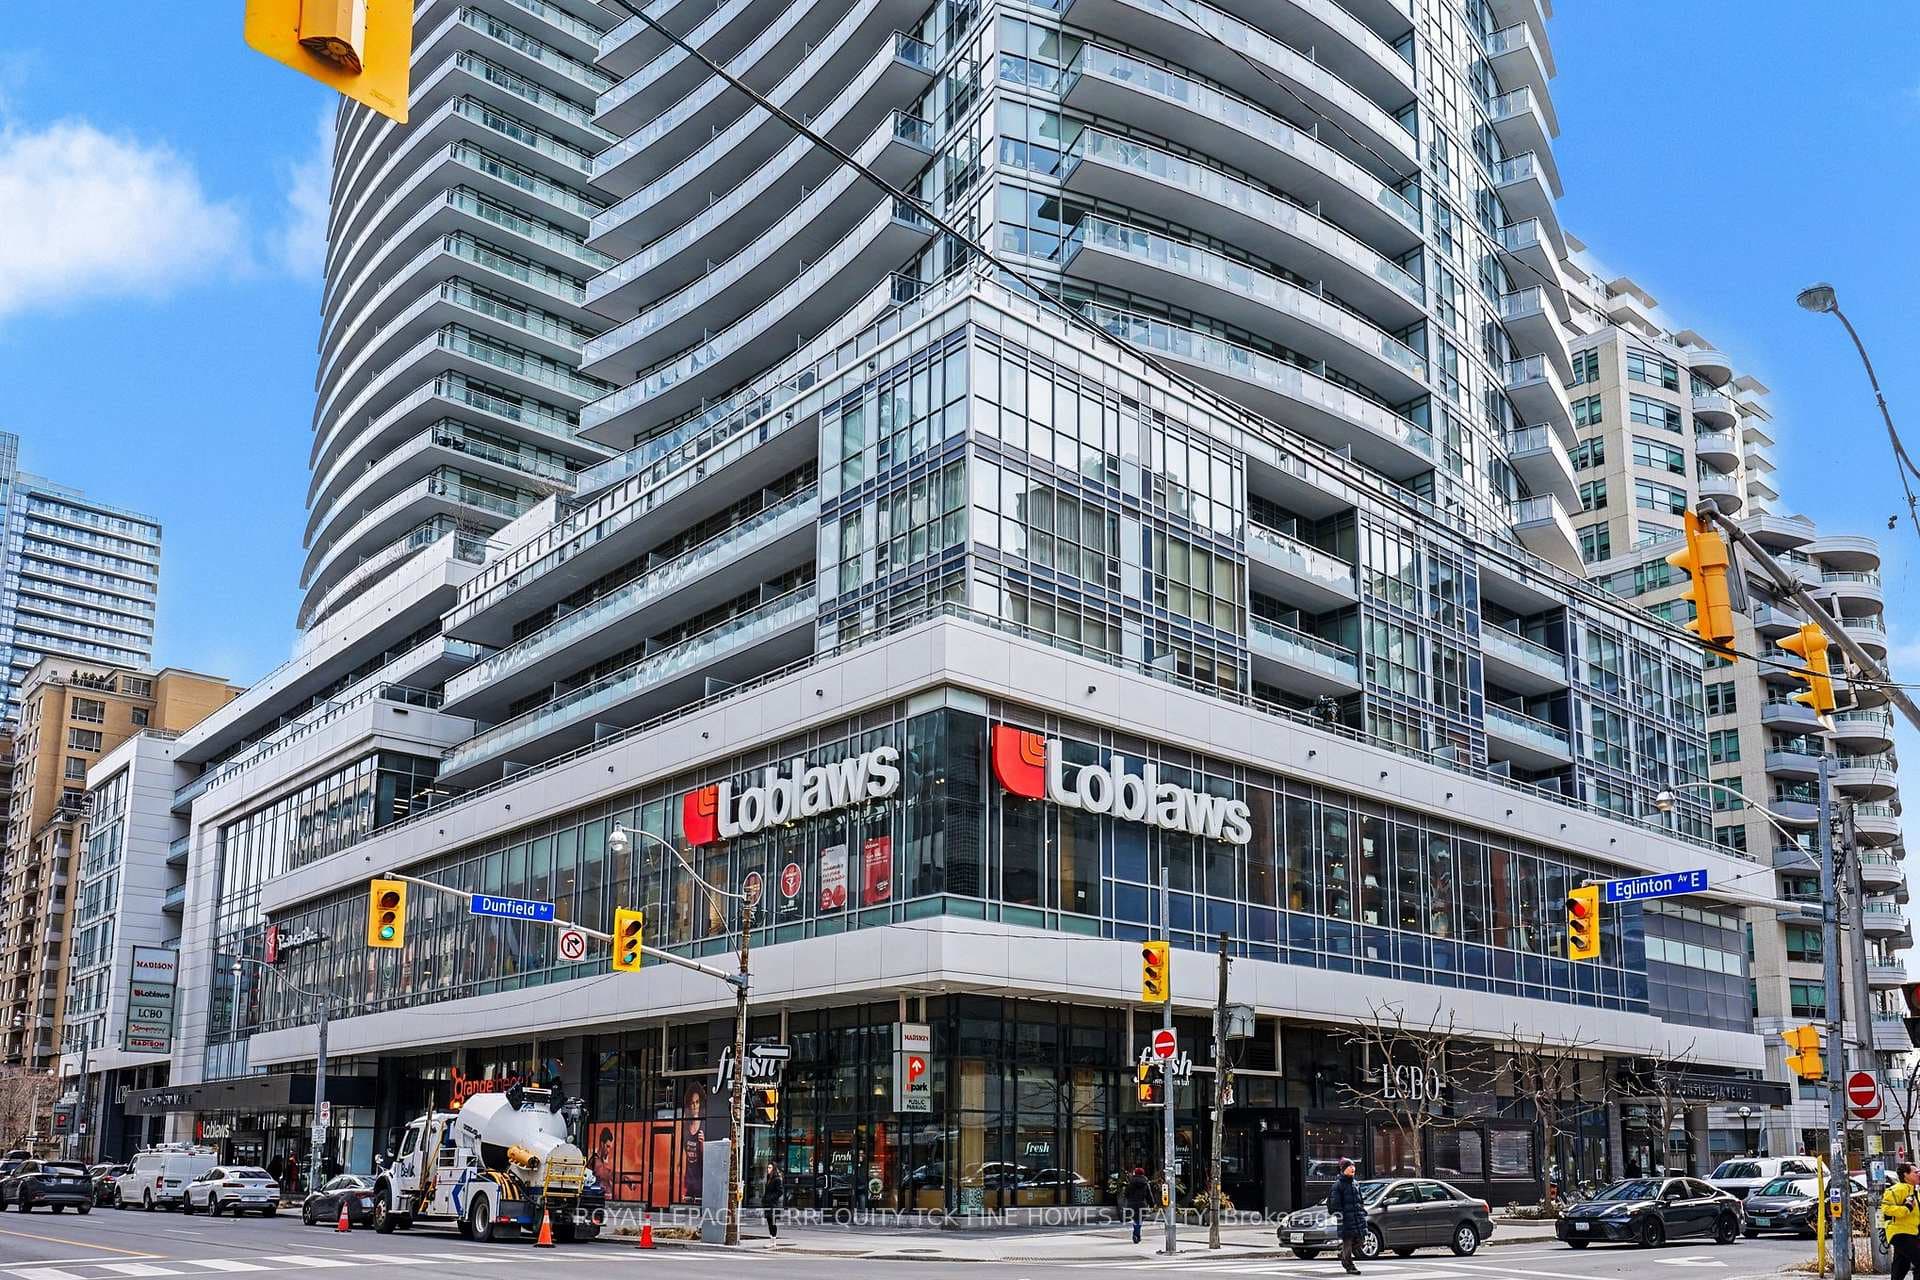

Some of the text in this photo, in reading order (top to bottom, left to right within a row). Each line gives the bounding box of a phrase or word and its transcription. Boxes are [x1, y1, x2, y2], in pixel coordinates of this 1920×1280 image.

[717, 746, 900, 838] Loblaws
[1046, 739, 1252, 845] Loblaws
[1615, 872, 1700, 899] Eglinton Av E
[483, 898, 548, 916] Dunfield Av
[136, 960, 173, 970] MADISON
[140, 989, 170, 999] Loblaws
[138, 1008, 163, 1019] LCBO
[130, 1039, 165, 1048] MADISON
[712, 1045, 777, 1094] frsh
[1382, 1063, 1440, 1101] LCBO
[202, 1119, 230, 1139] Loblaws
[831, 1150, 852, 1164] fresh
[1024, 1141, 1050, 1155] fresh
